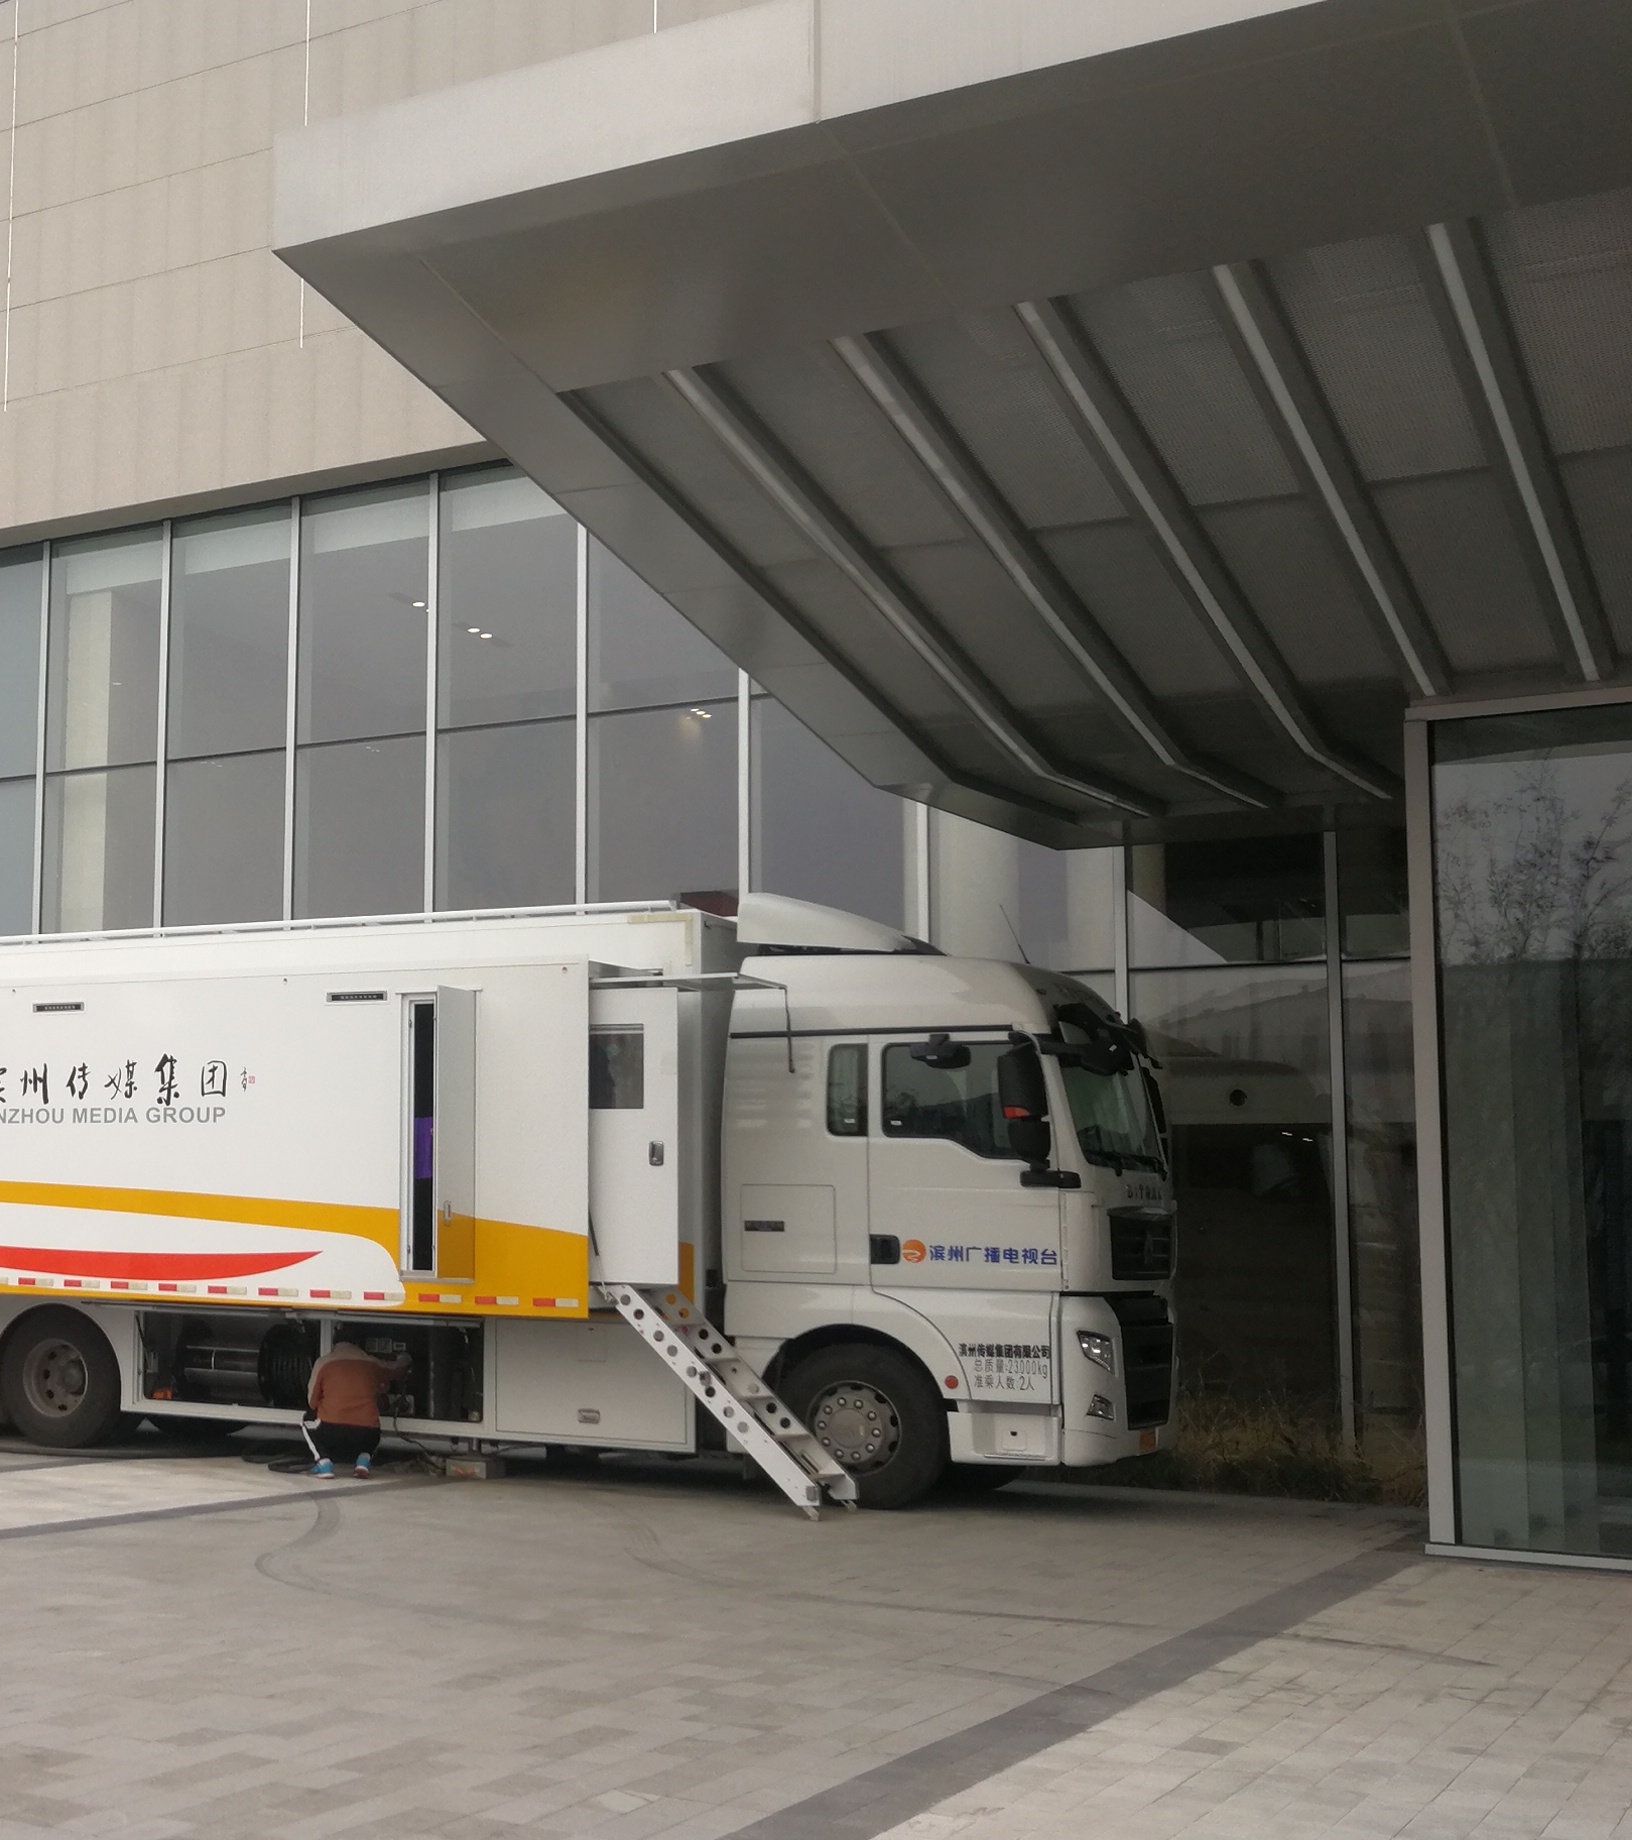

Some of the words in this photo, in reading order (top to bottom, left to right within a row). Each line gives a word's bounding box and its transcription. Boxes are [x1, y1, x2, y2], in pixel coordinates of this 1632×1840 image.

[72, 1108, 138, 1124] MEDIA
[145, 1107, 226, 1124] GROUP
[929, 1245, 1058, 1265] 滨州广播电视台
[959, 1343, 1050, 1359] 滨州传媒集团有限公司
[974, 1358, 1048, 1379] 总质量:23000kg
[974, 1375, 1035, 1391] 准乘人数:2人
